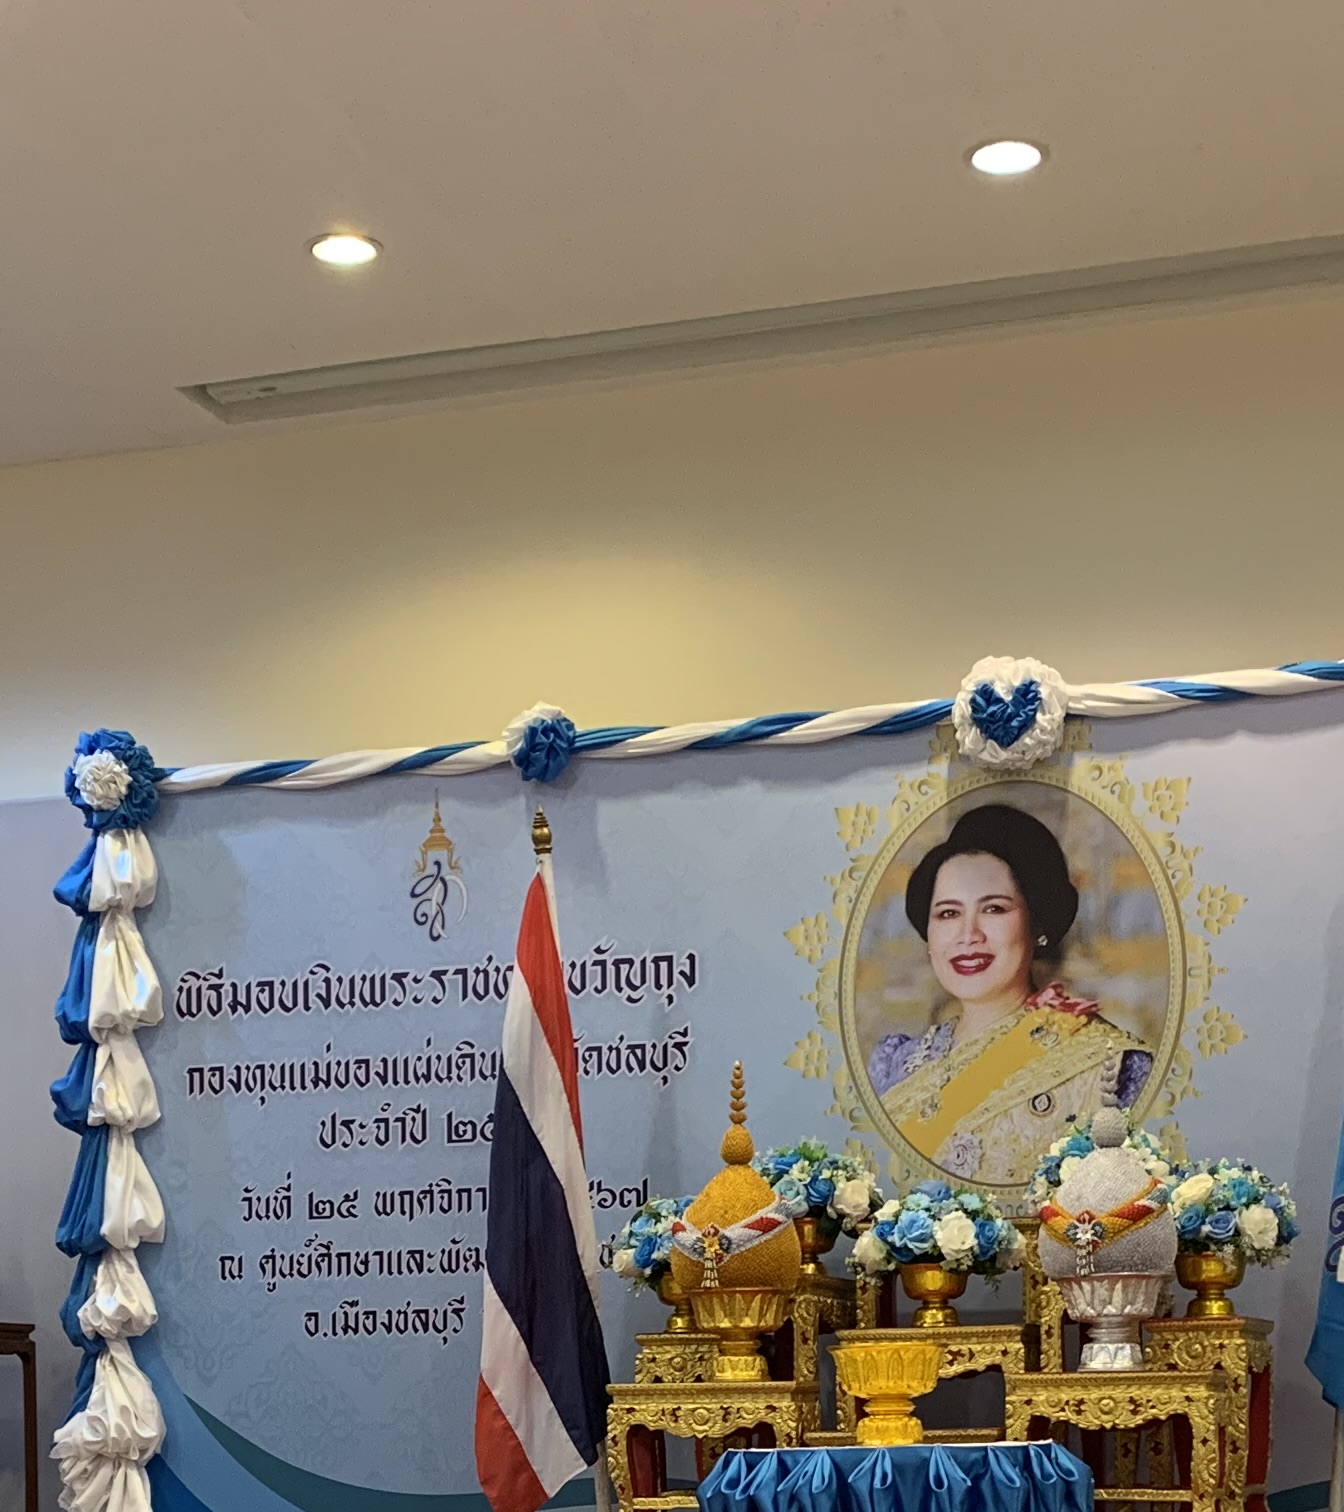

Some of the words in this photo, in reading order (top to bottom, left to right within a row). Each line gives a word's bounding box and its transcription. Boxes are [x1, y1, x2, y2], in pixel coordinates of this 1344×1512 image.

[318, 1103, 428, 1150] ประจำปี
[241, 1171, 292, 1223] วันที่
[308, 1189, 359, 1221] ๒๕
[374, 1178, 488, 1222] พฤศจิกา
[218, 1254, 244, 1281] ณ
[303, 1295, 467, 1347] อ.เมืองชลบุรี
